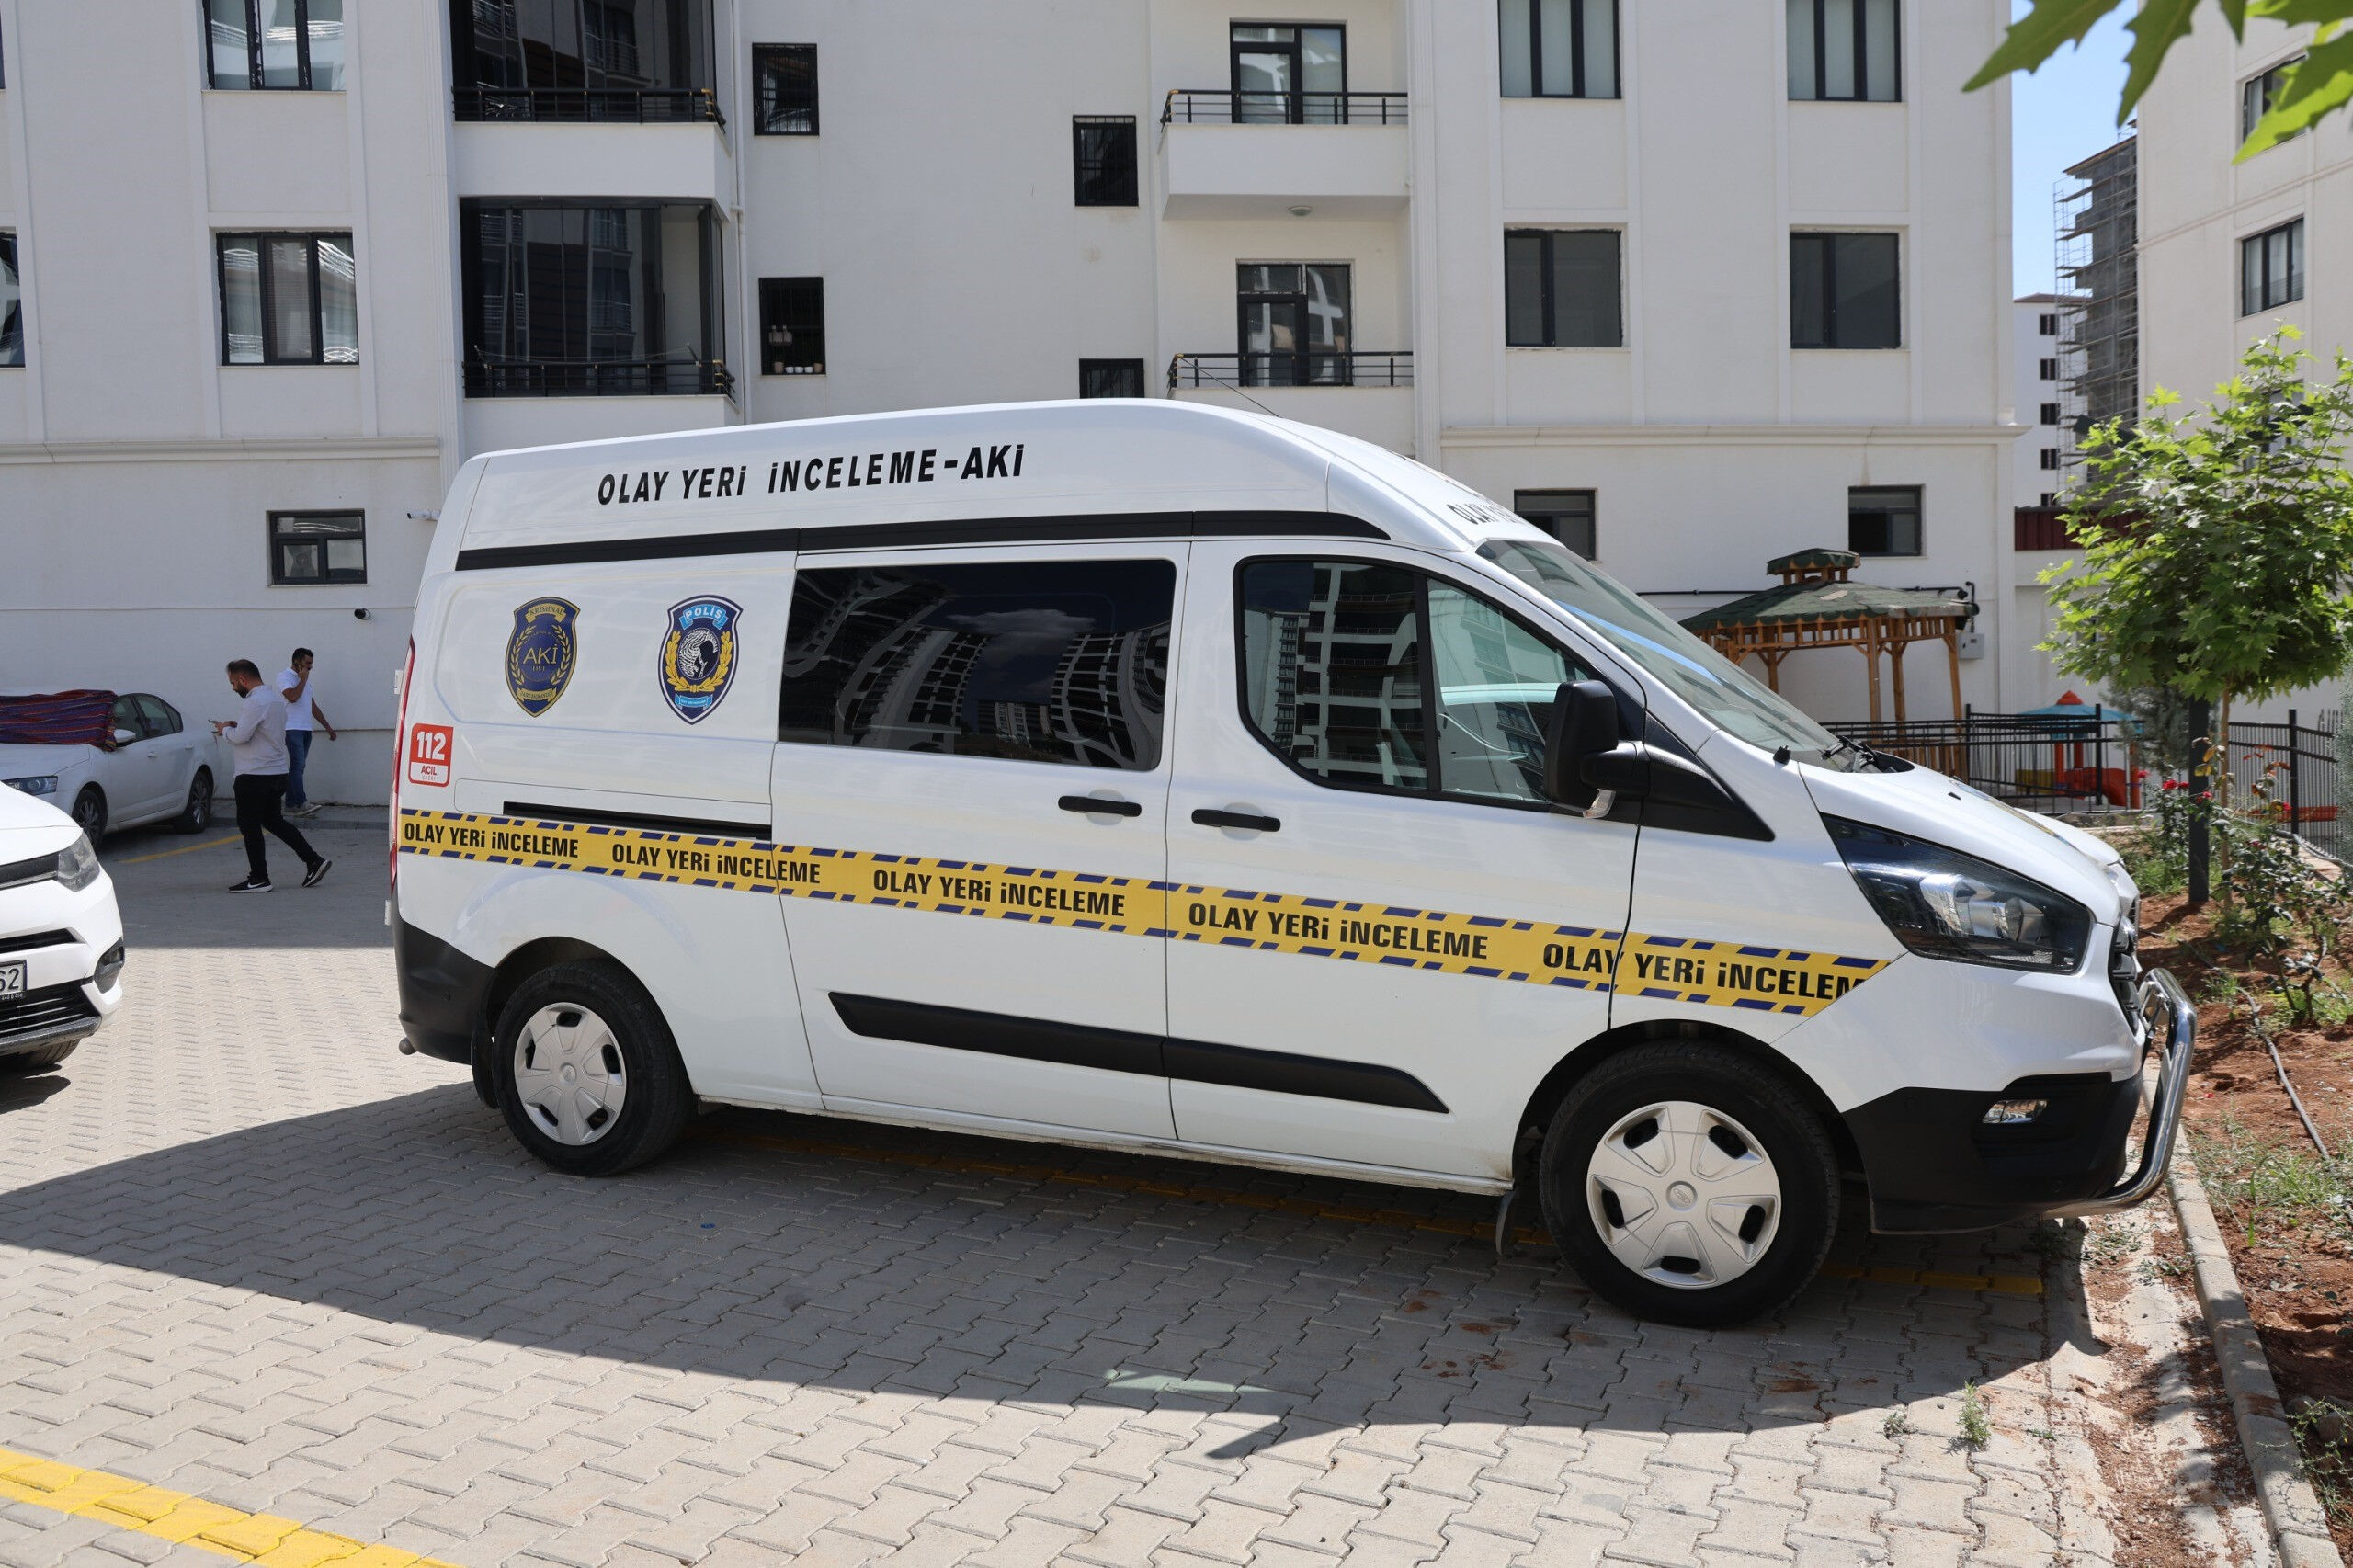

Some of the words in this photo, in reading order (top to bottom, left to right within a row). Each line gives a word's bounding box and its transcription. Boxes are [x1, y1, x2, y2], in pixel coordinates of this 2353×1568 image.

[597, 471, 670, 506] OLAY
[417, 732, 446, 760] 112
[404, 823, 445, 844] OLAY
[612, 843, 661, 867] OLAY
[873, 869, 933, 895] OLAY
[1188, 903, 1260, 933] OLAY
[1542, 943, 1625, 975] OLAY
